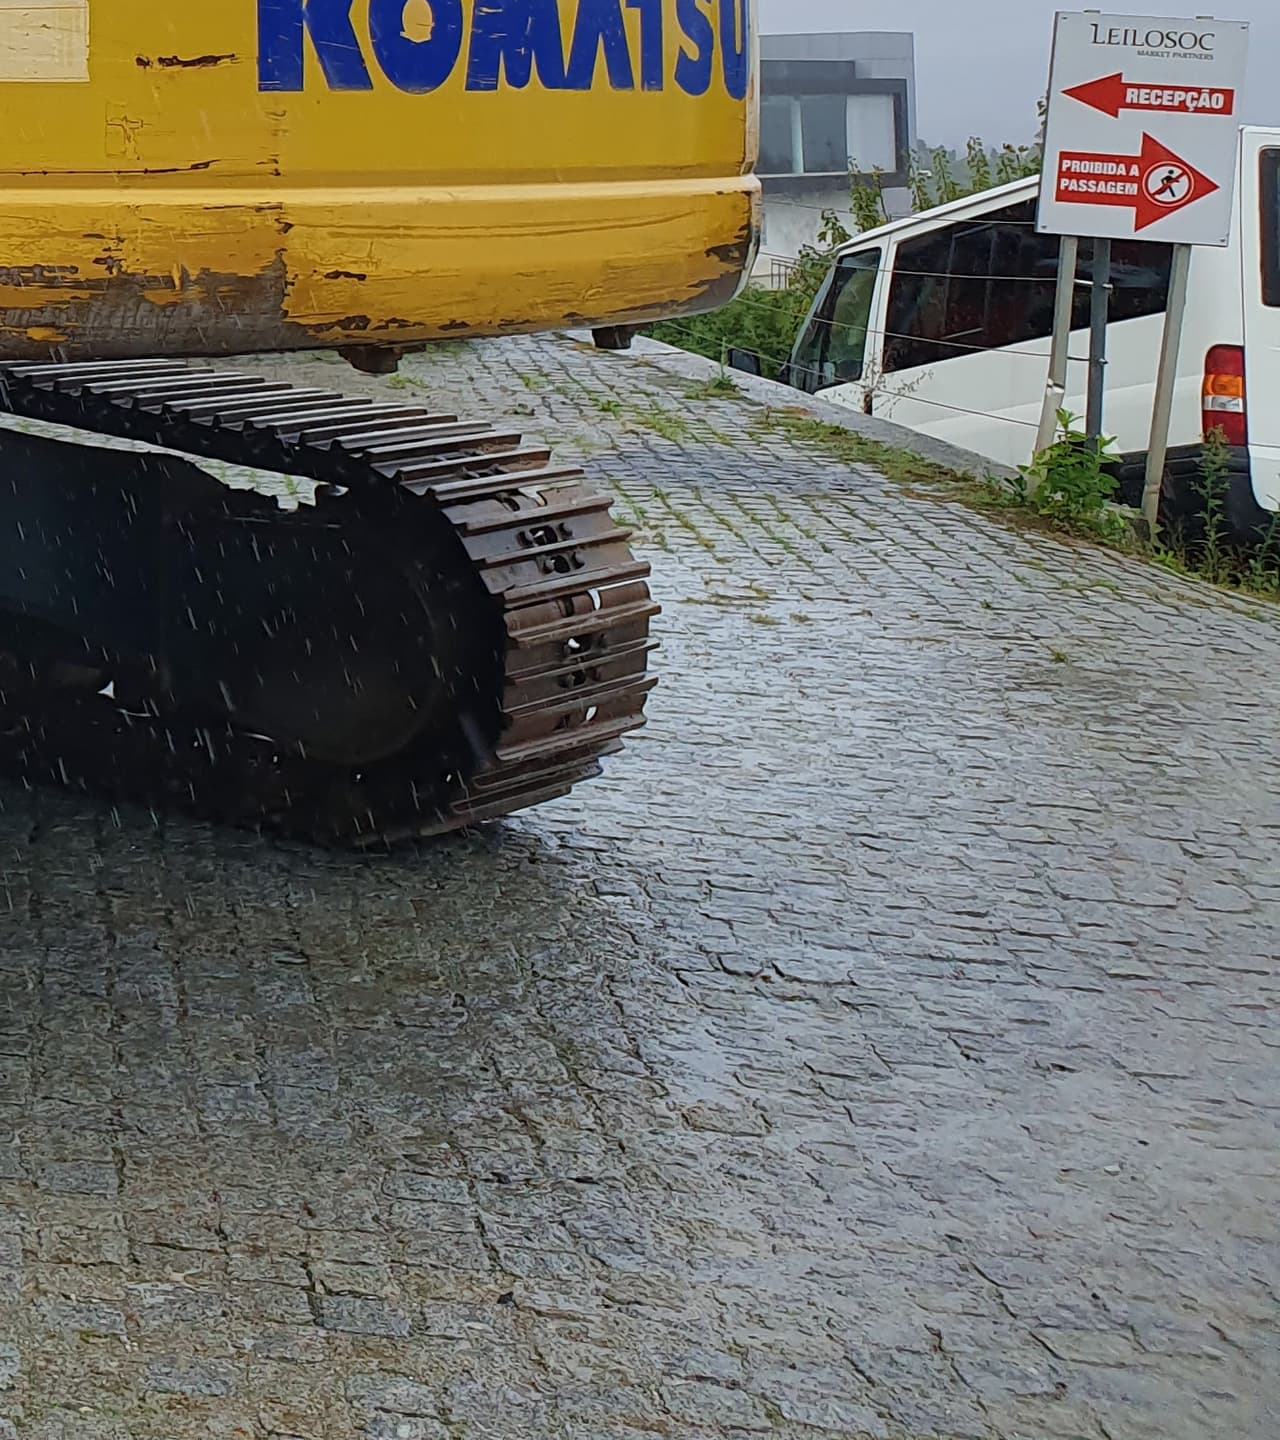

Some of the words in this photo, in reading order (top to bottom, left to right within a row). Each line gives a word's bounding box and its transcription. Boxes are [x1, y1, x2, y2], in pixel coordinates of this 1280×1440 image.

[1091, 23, 1215, 50] LEILOSOC
[1126, 88, 1224, 111] RECEPÇÃO
[1062, 160, 1126, 175] PROIBIDA
[1129, 164, 1139, 176] A
[1060, 178, 1138, 195] PASSAGEM
